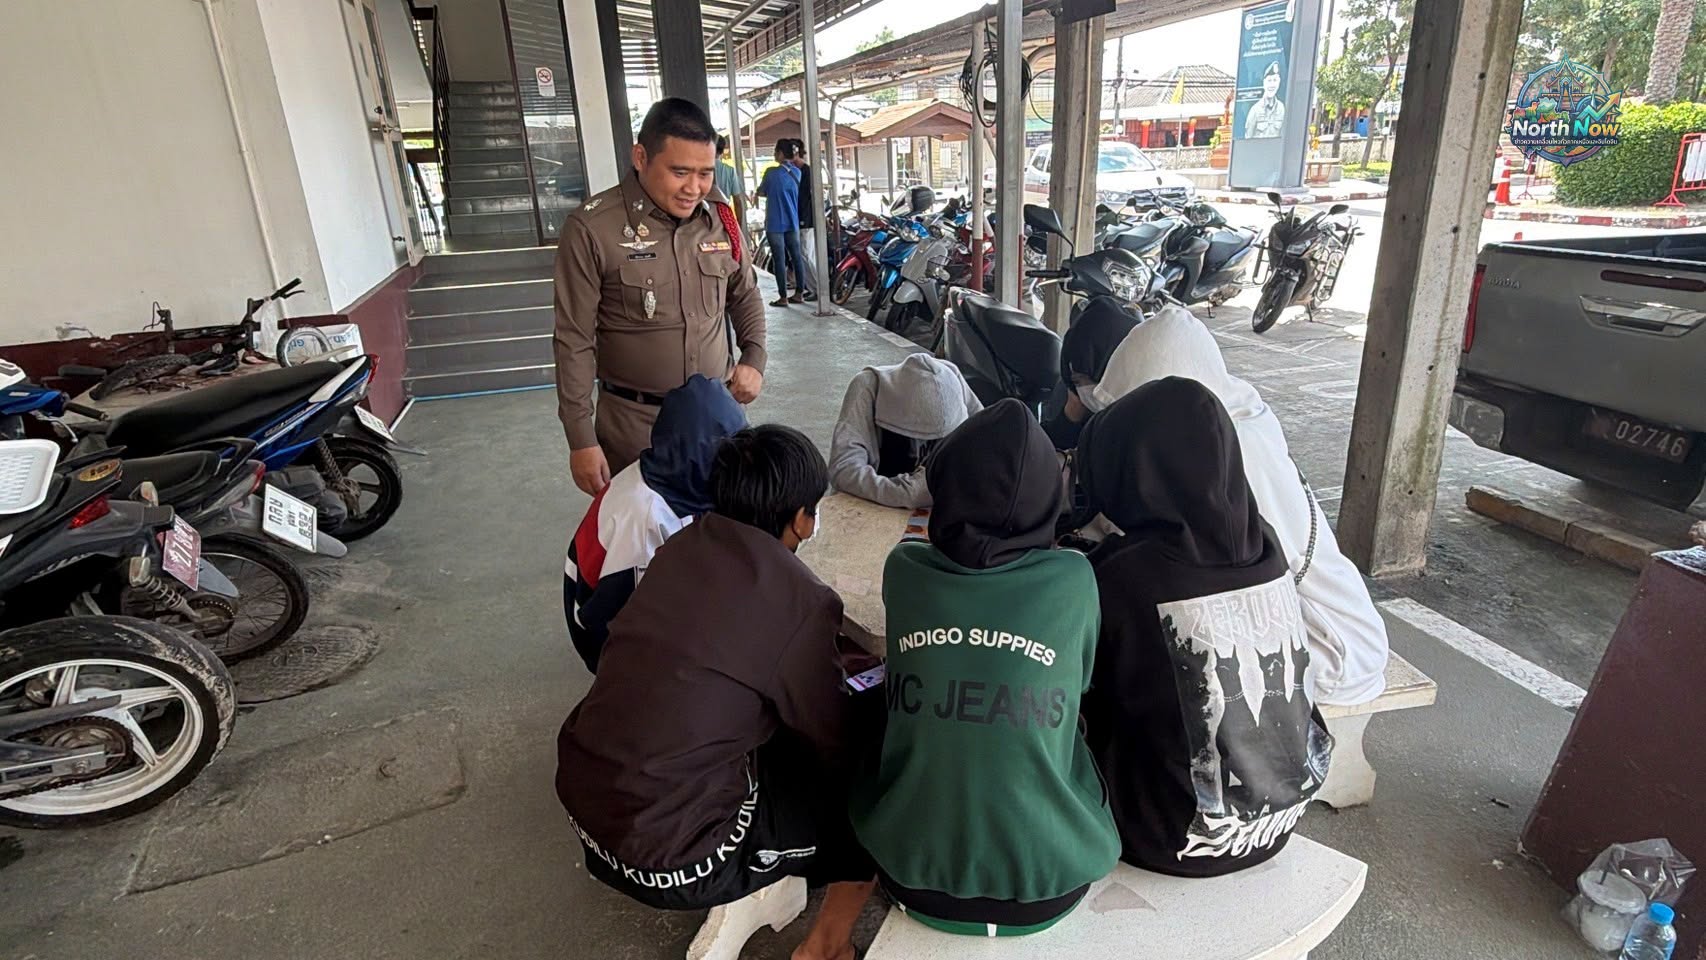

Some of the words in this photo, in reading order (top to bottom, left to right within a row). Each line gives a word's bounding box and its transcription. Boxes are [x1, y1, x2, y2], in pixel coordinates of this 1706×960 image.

[1615, 420, 1686, 457] 02746
[899, 627, 963, 653] INDIGO
[968, 628, 1056, 666] SUPPIES
[886, 671, 923, 714] MC
[934, 679, 1066, 729] JEANS
[622, 857, 714, 889] KUDILU
